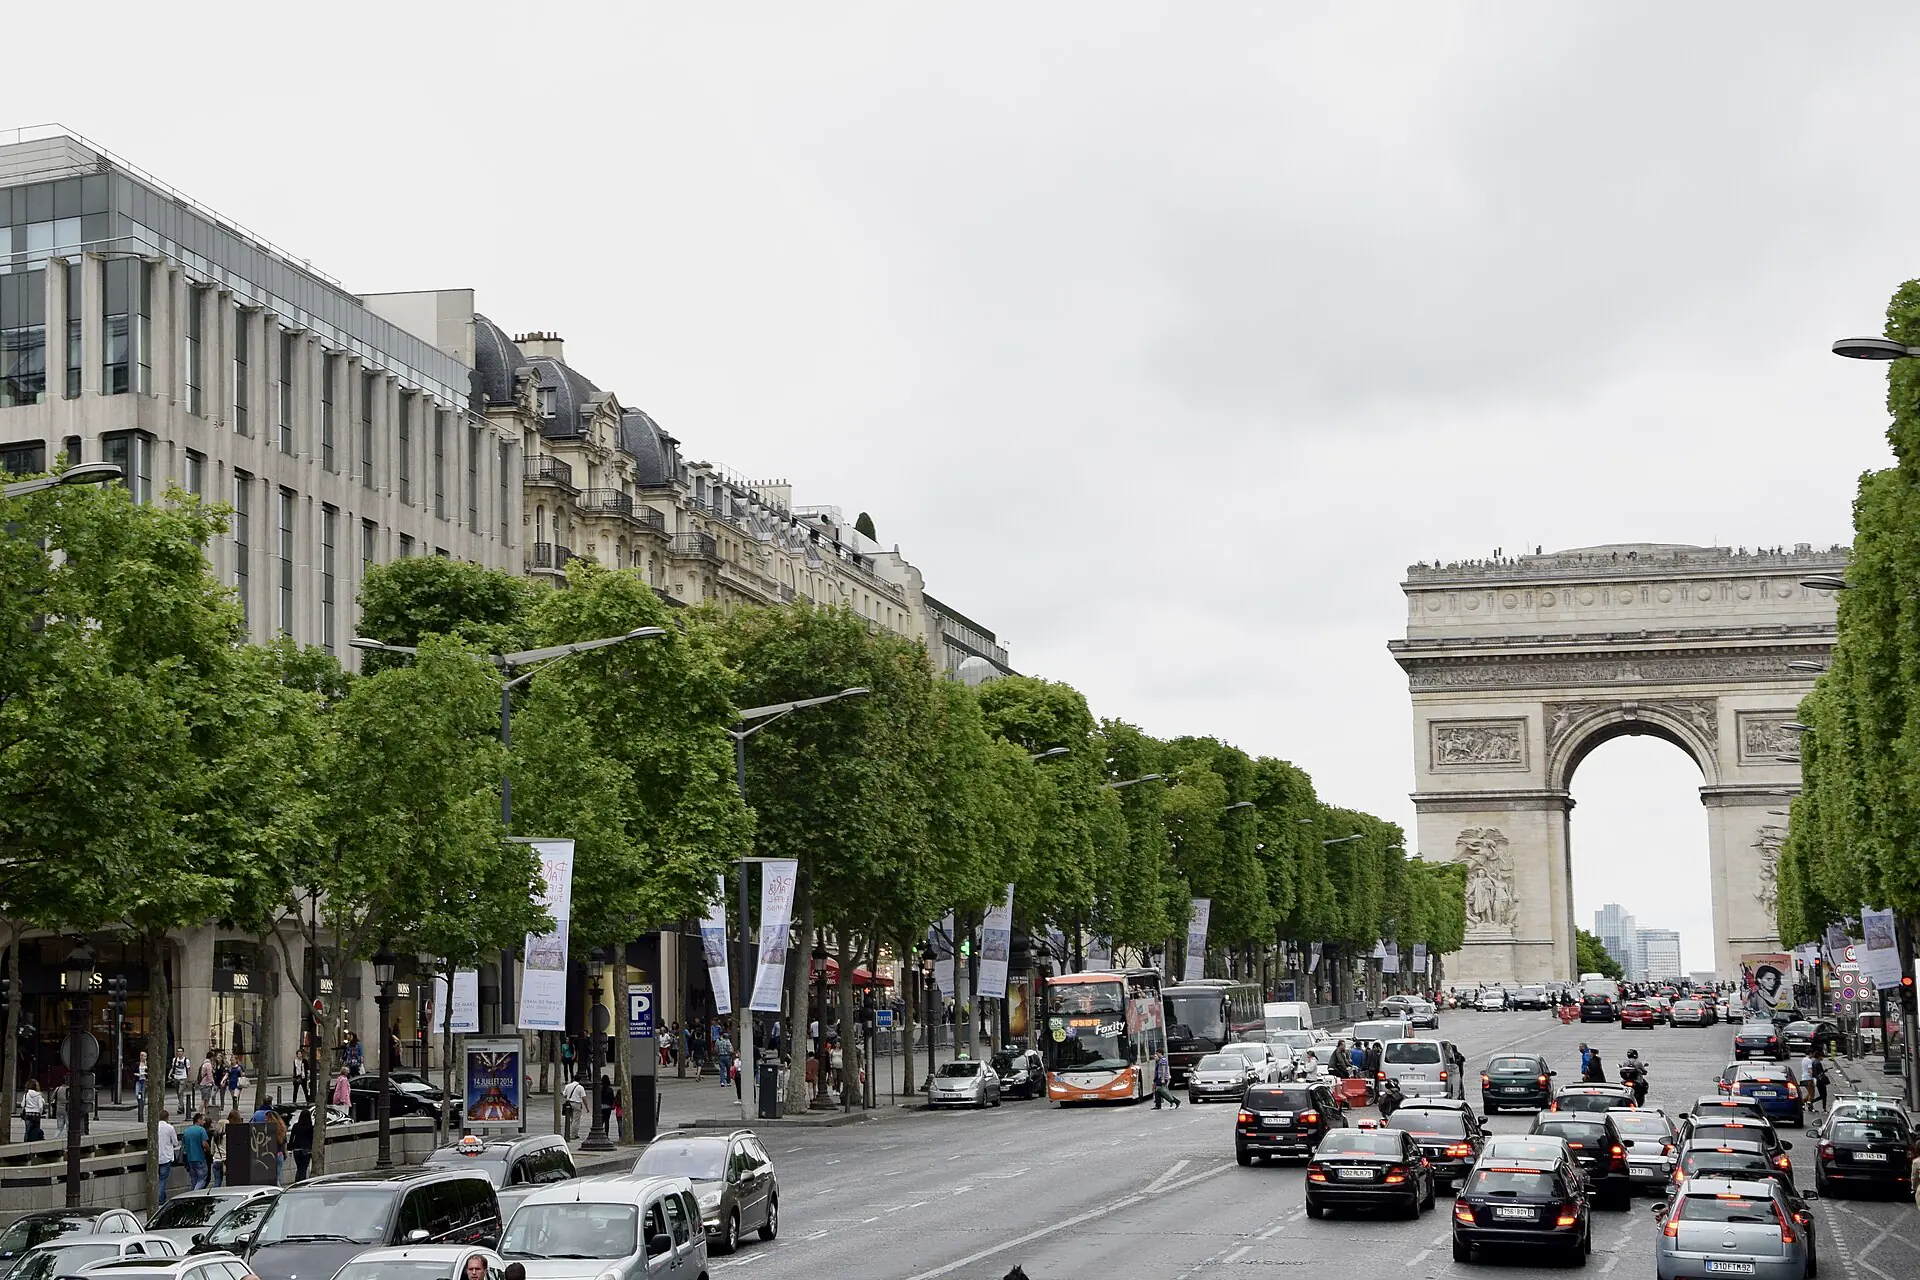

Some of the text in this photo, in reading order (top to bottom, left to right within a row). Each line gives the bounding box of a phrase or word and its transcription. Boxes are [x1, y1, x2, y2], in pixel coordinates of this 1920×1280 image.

[233, 973, 249, 986] BOSS
[320, 979, 334, 991] BOSS
[397, 983, 410, 994] BOSS
[631, 995, 650, 1021] P
[1095, 1021, 1126, 1035] Foxity
[473, 1078, 514, 1086] 14 JUILLET 2014
